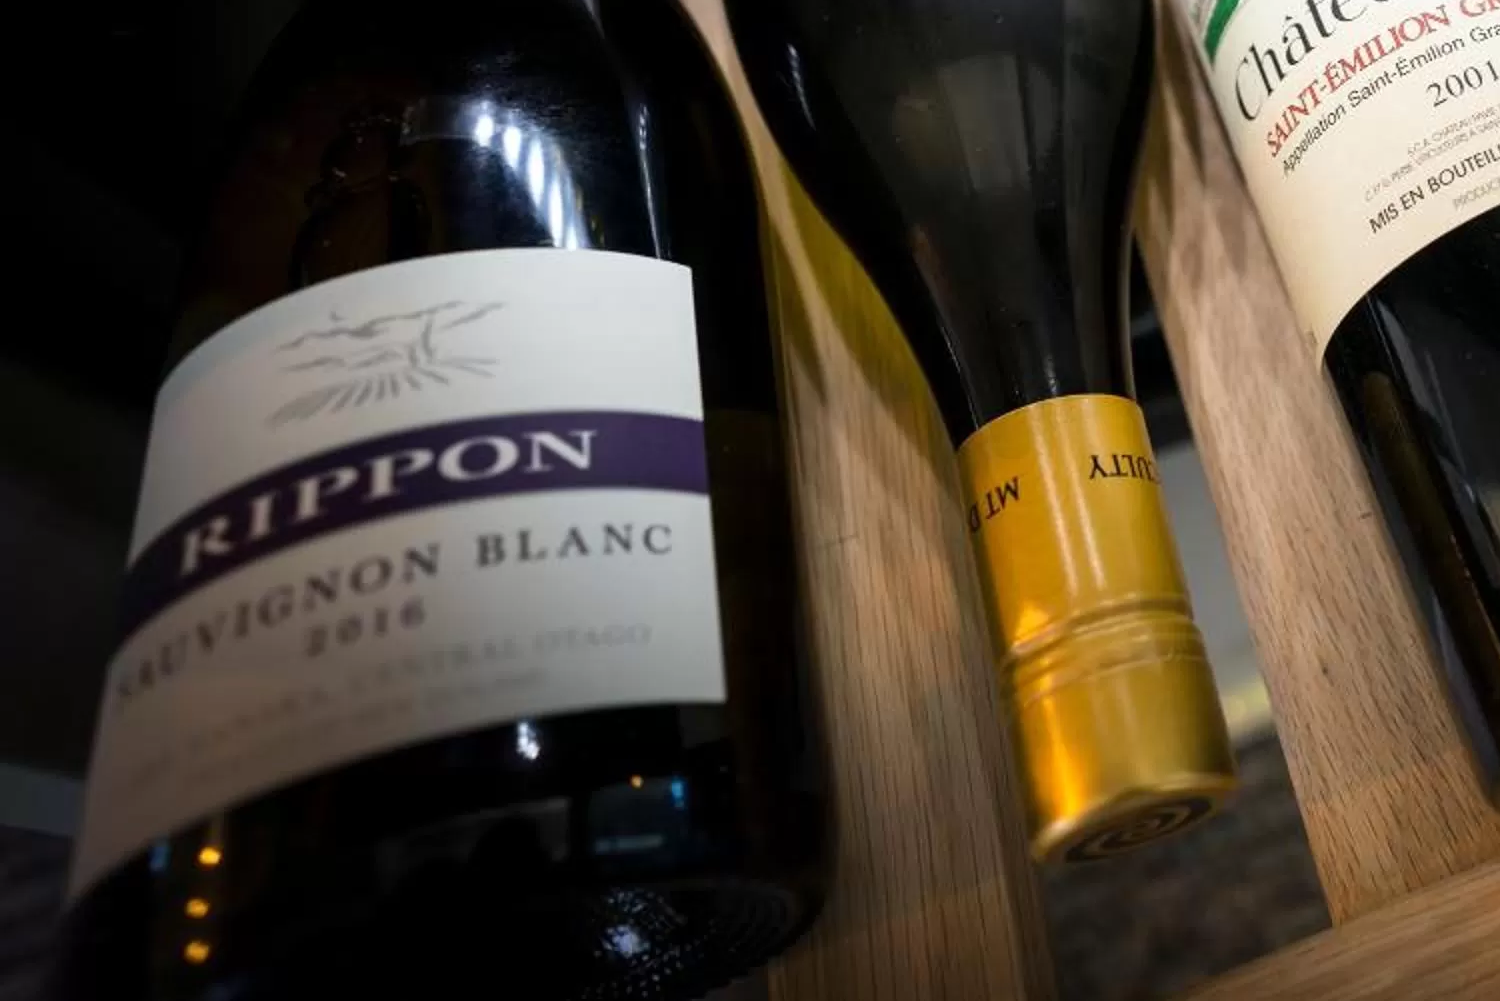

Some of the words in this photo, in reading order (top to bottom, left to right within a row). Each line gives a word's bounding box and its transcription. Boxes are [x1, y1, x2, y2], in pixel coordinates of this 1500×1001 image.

[1264, 4, 1452, 158] SAINT-ÉMILION
[1282, 102, 1348, 180] Appellation
[1347, 36, 1466, 109] Saint-Émilion
[1426, 59, 1500, 109] 2001
[1368, 203, 1400, 234] MIS
[1400, 184, 1426, 211] EN
[179, 429, 598, 577] RIPPON
[984, 475, 1021, 520] MT
[475, 523, 673, 567] BLANC
[304, 597, 428, 658] 2016
